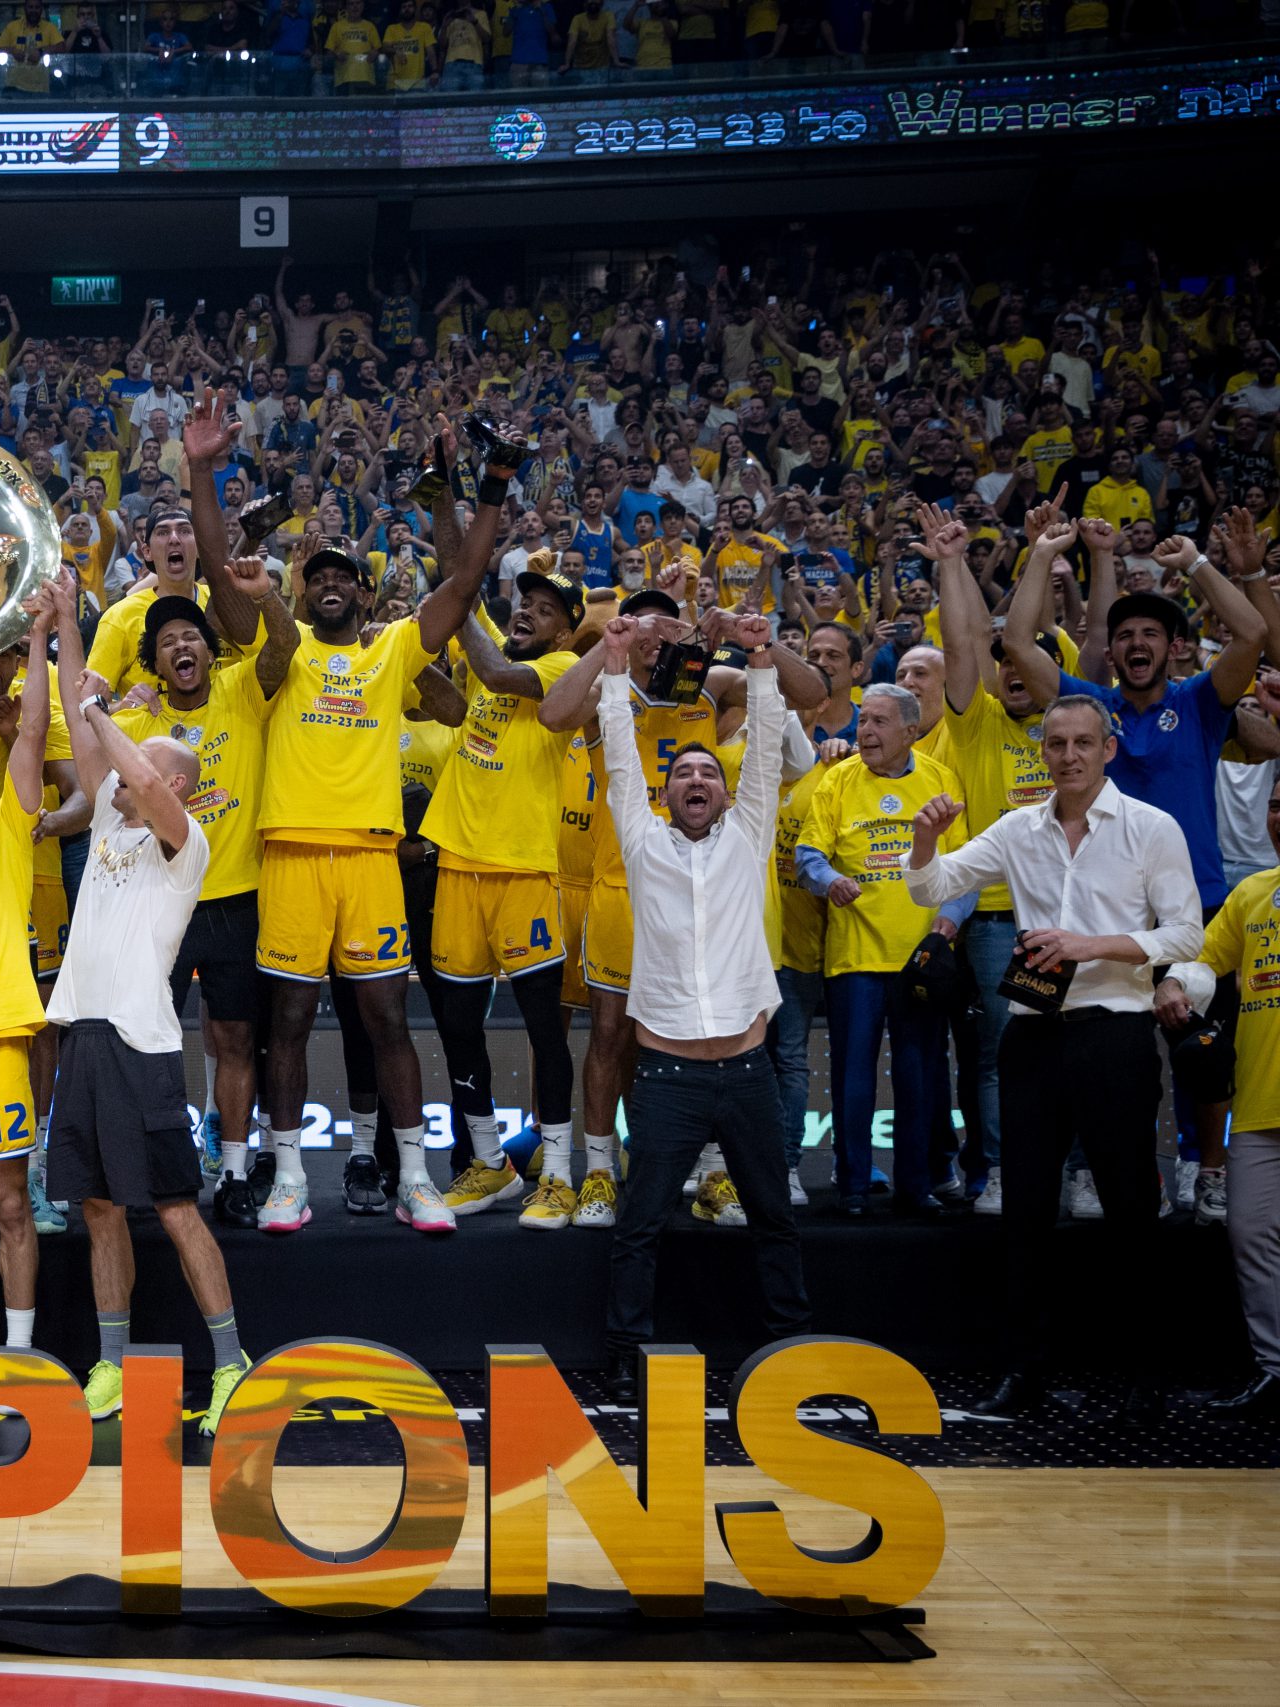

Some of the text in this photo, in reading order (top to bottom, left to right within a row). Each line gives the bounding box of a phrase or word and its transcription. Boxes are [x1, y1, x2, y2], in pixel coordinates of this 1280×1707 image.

[573, 111, 786, 155] 2022-23
[799, 106, 867, 142] סל
[887, 88, 1157, 137] Winner
[134, 116, 170, 166] 9
[253, 205, 276, 237] 9
[75, 278, 116, 302] יציאה
[676, 679, 699, 692] CHAMP
[319, 700, 354, 712] Winner
[301, 712, 352, 728] 2022-23
[491, 708, 508, 723] תל
[203, 730, 230, 752] מכבי
[203, 752, 222, 768] תל
[407, 761, 433, 776] מכבי
[866, 825, 897, 840] אביב
[870, 840, 912, 852] אלופת
[529, 917, 553, 952] 4
[267, 948, 298, 963] Rapyd
[601, 965, 631, 982] Rapyd
[1013, 970, 1058, 996] CHAMP
